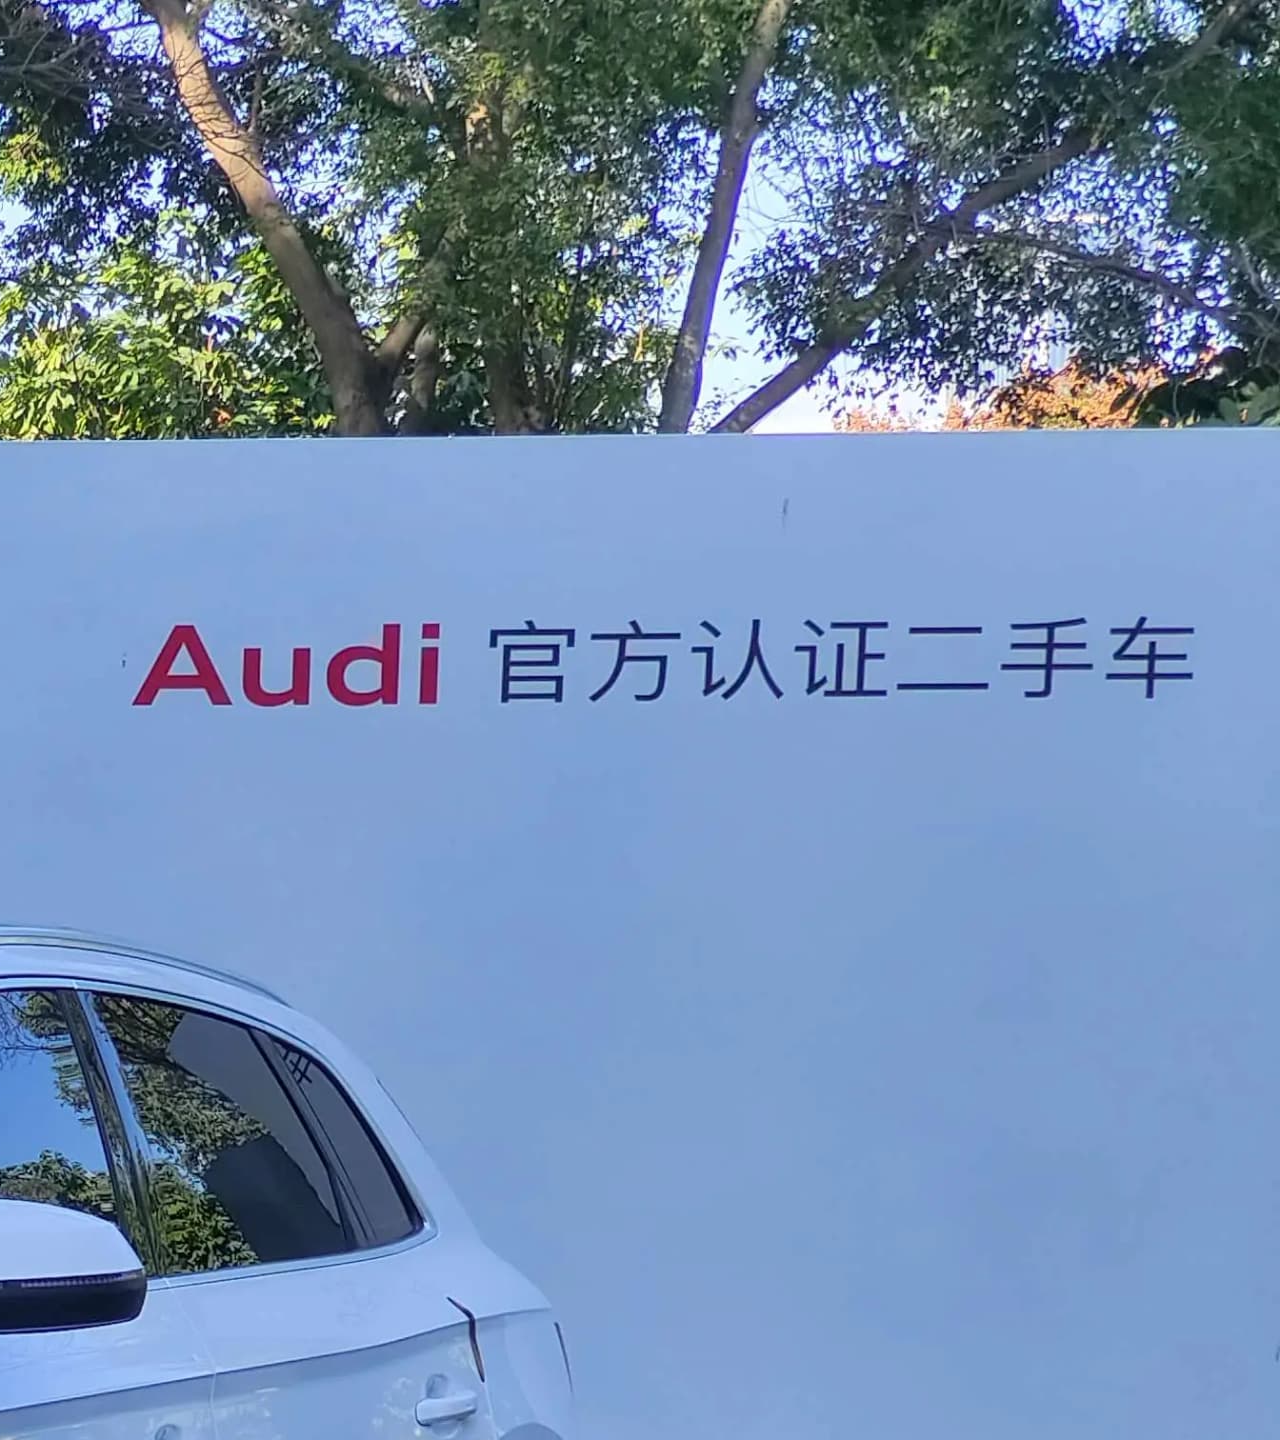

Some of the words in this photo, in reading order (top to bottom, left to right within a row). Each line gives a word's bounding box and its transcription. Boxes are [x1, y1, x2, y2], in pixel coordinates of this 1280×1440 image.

[132, 624, 440, 707] Audi
[489, 616, 1194, 704] 官方认证二手车
